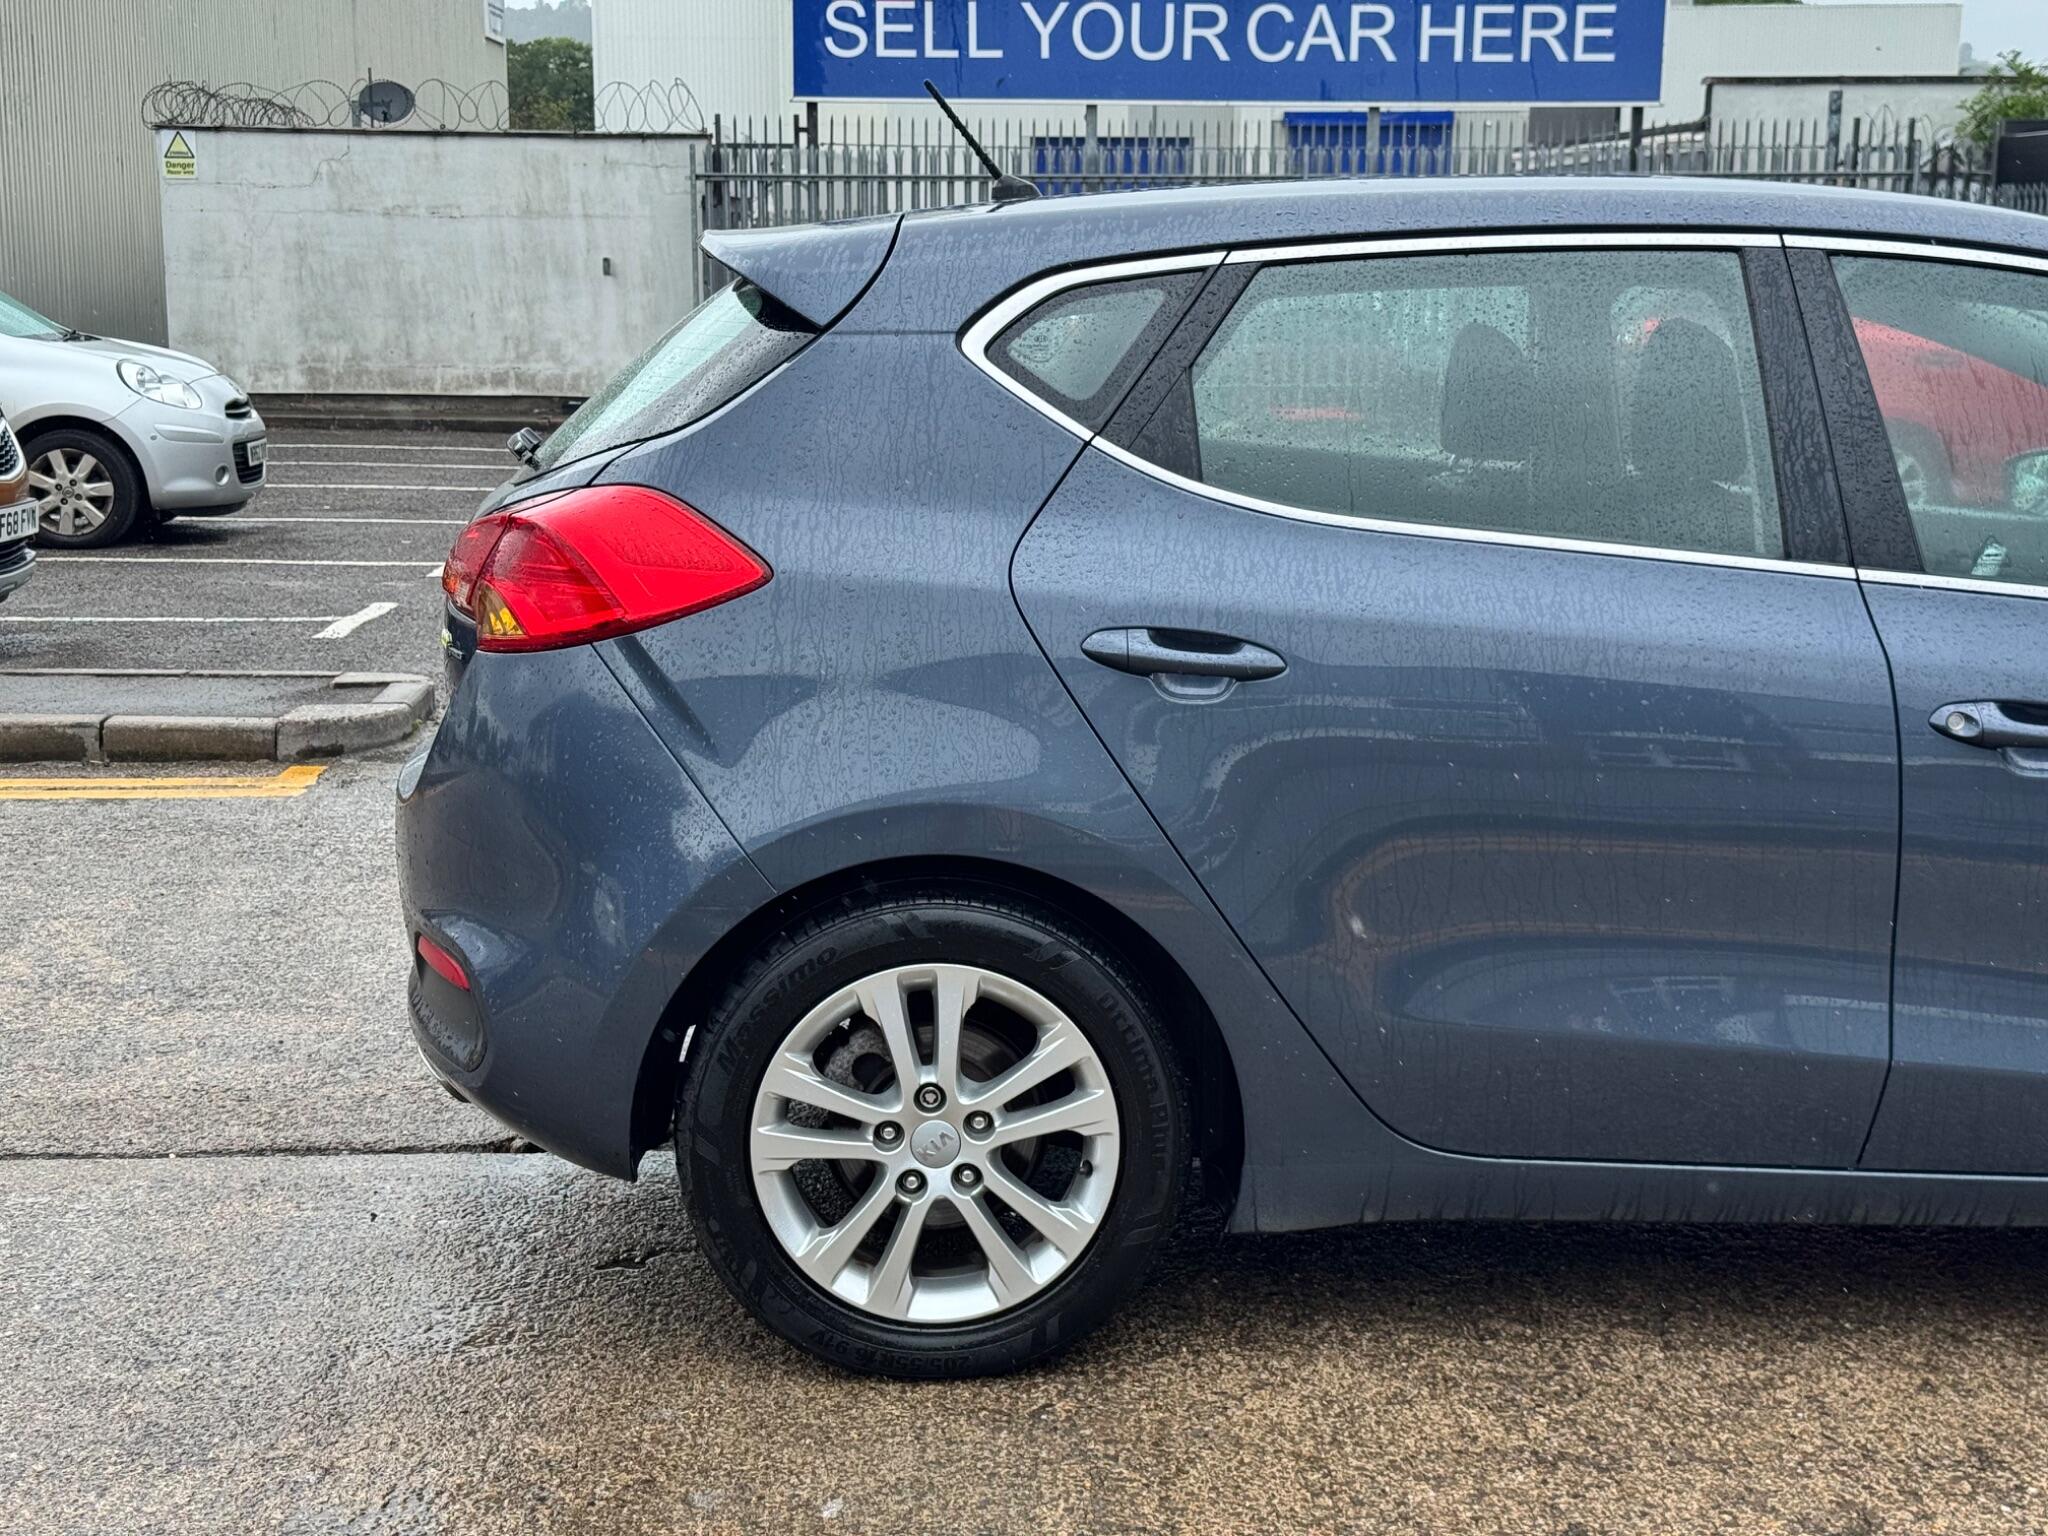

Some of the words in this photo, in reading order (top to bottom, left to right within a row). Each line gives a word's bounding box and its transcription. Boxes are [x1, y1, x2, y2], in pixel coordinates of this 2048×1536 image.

[824, 0, 1004, 58] SELL
[1020, 2, 1231, 61] YOUR
[1247, 3, 1398, 63] CAR
[1419, 4, 1617, 63] HERE
[165, 160, 195, 170] Danger
[717, 946, 837, 1075] Massimo
[915, 1131, 955, 1161] KIA
